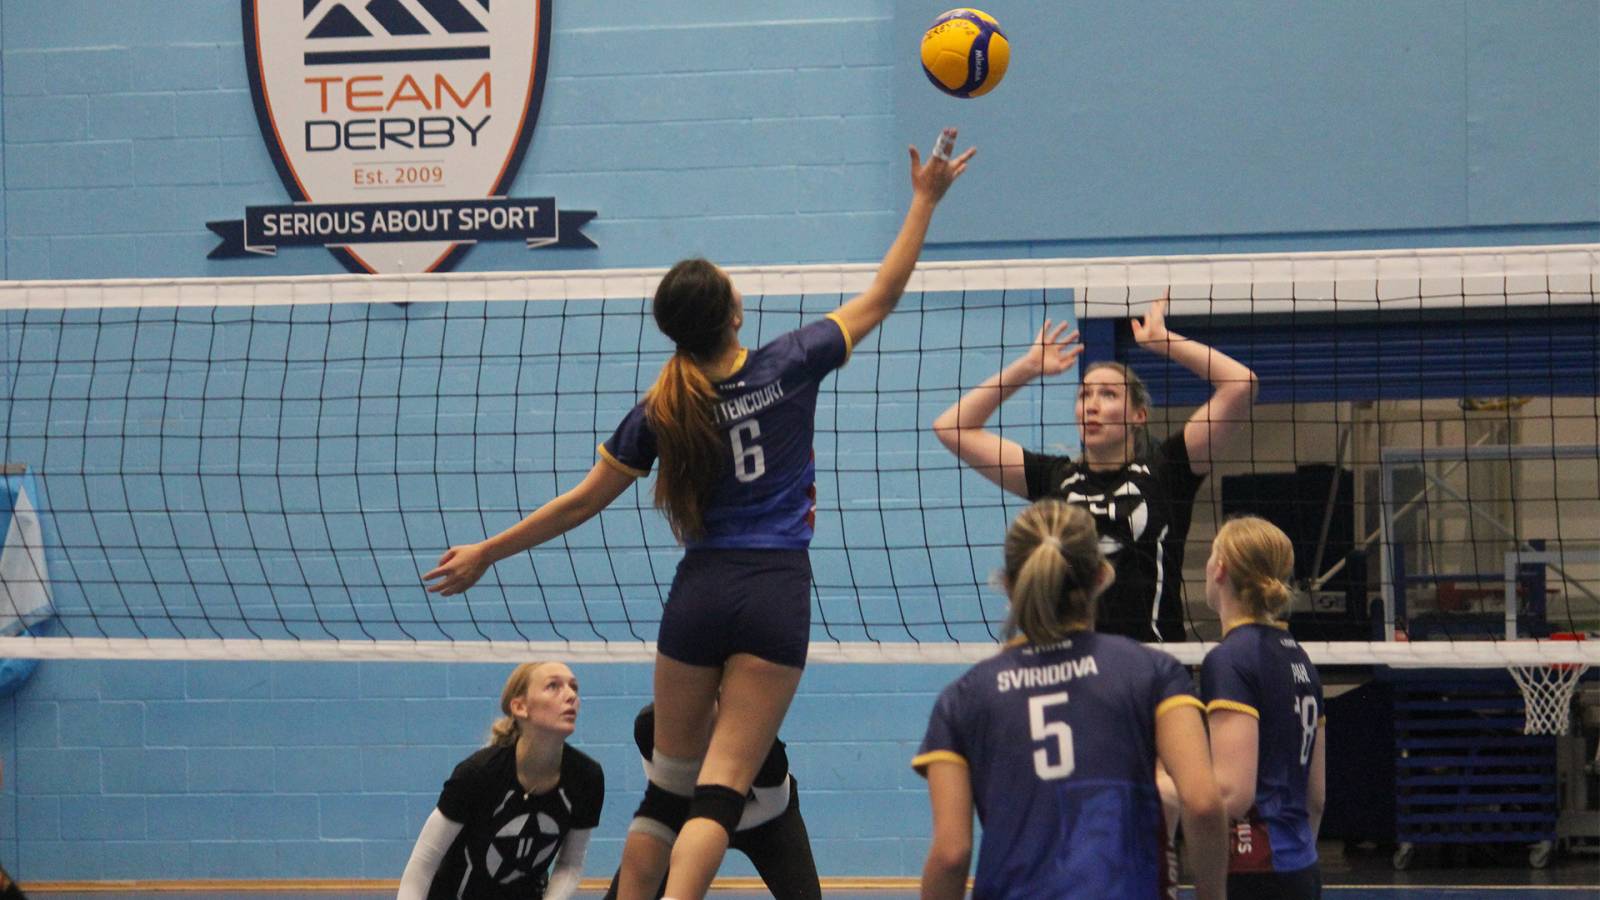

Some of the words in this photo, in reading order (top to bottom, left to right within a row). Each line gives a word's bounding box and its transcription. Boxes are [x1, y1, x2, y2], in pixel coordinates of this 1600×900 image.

[304, 72, 492, 113] TEAM
[305, 115, 492, 152] DERBY
[354, 168, 389, 185] Est.
[395, 166, 444, 184] 2009
[263, 211, 365, 236] SERIOUS
[371, 209, 449, 233] ABOUT
[459, 206, 539, 230] SPORT
[729, 418, 765, 482] 6
[997, 655, 1098, 692] SVIRIDOVA
[1028, 691, 1075, 781] 5
[1237, 823, 1252, 854] IUS
